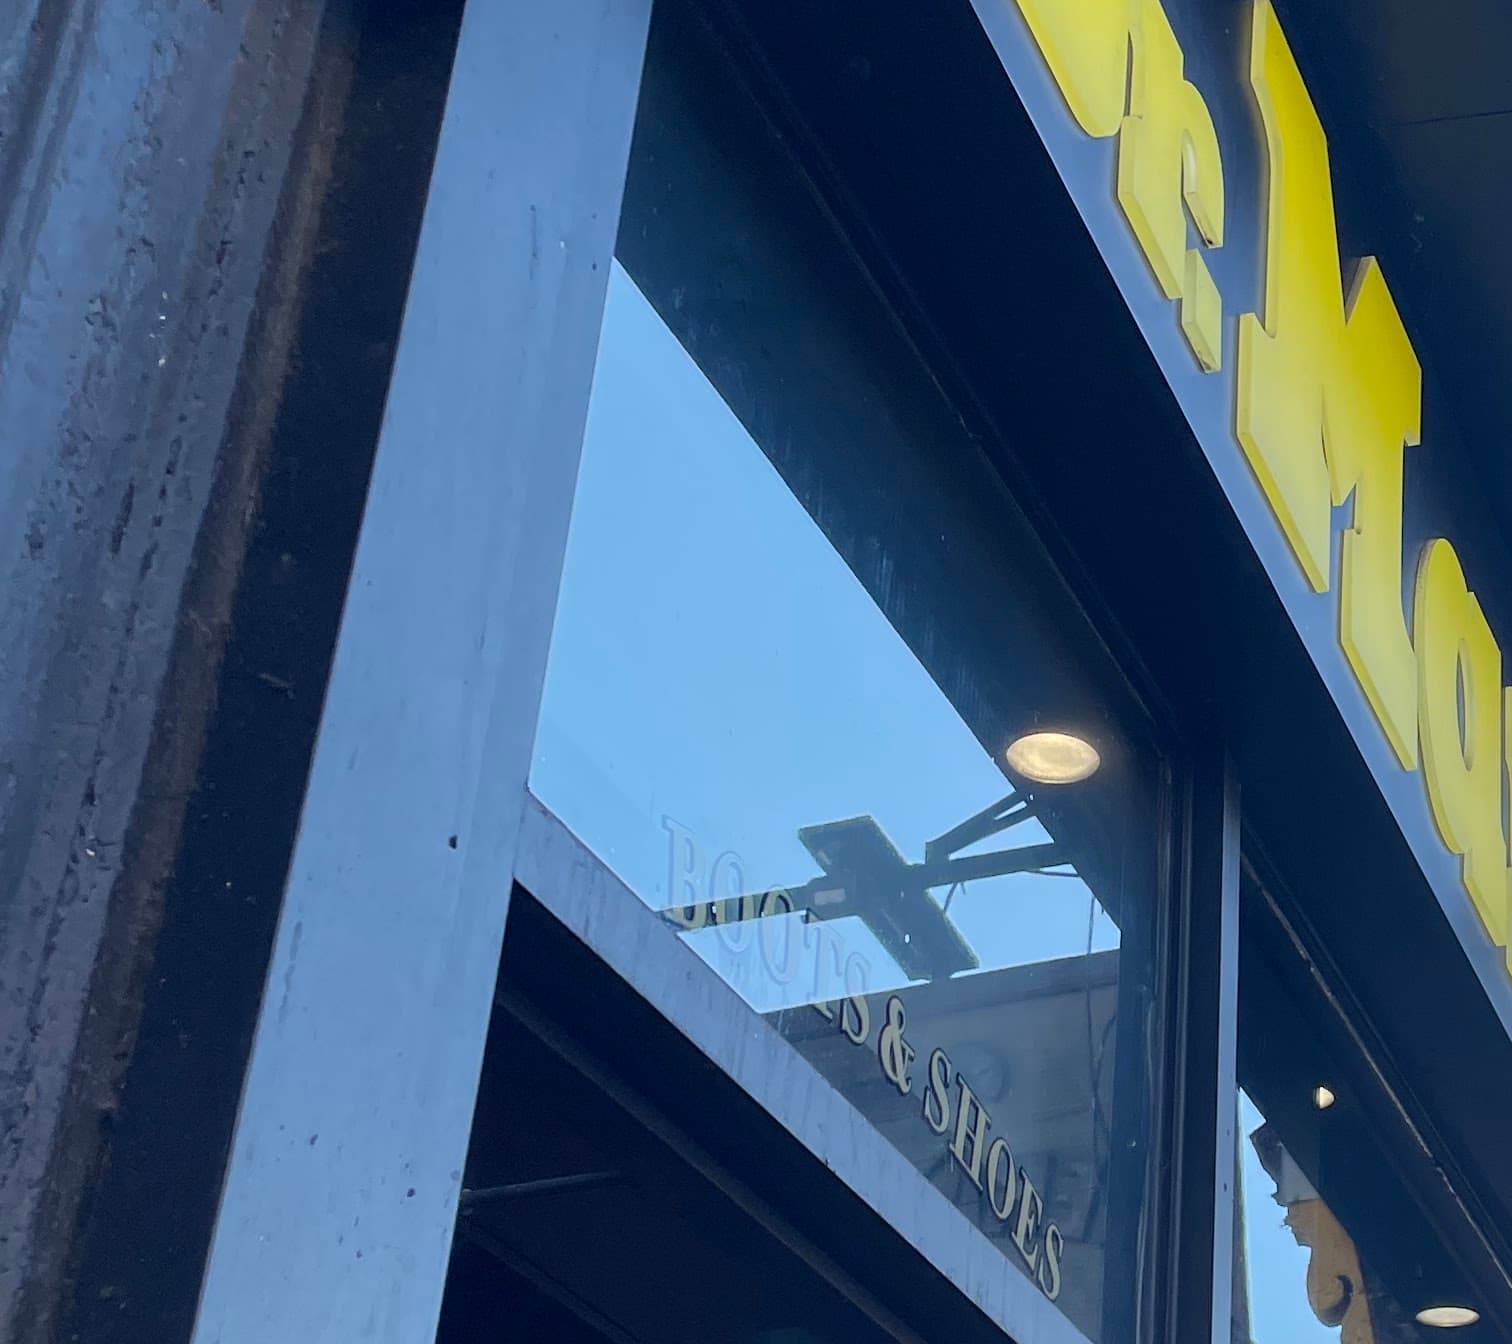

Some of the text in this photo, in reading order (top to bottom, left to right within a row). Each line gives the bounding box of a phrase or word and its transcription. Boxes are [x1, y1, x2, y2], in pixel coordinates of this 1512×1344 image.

[661, 815, 1065, 1302] BOOTS & SHOES
